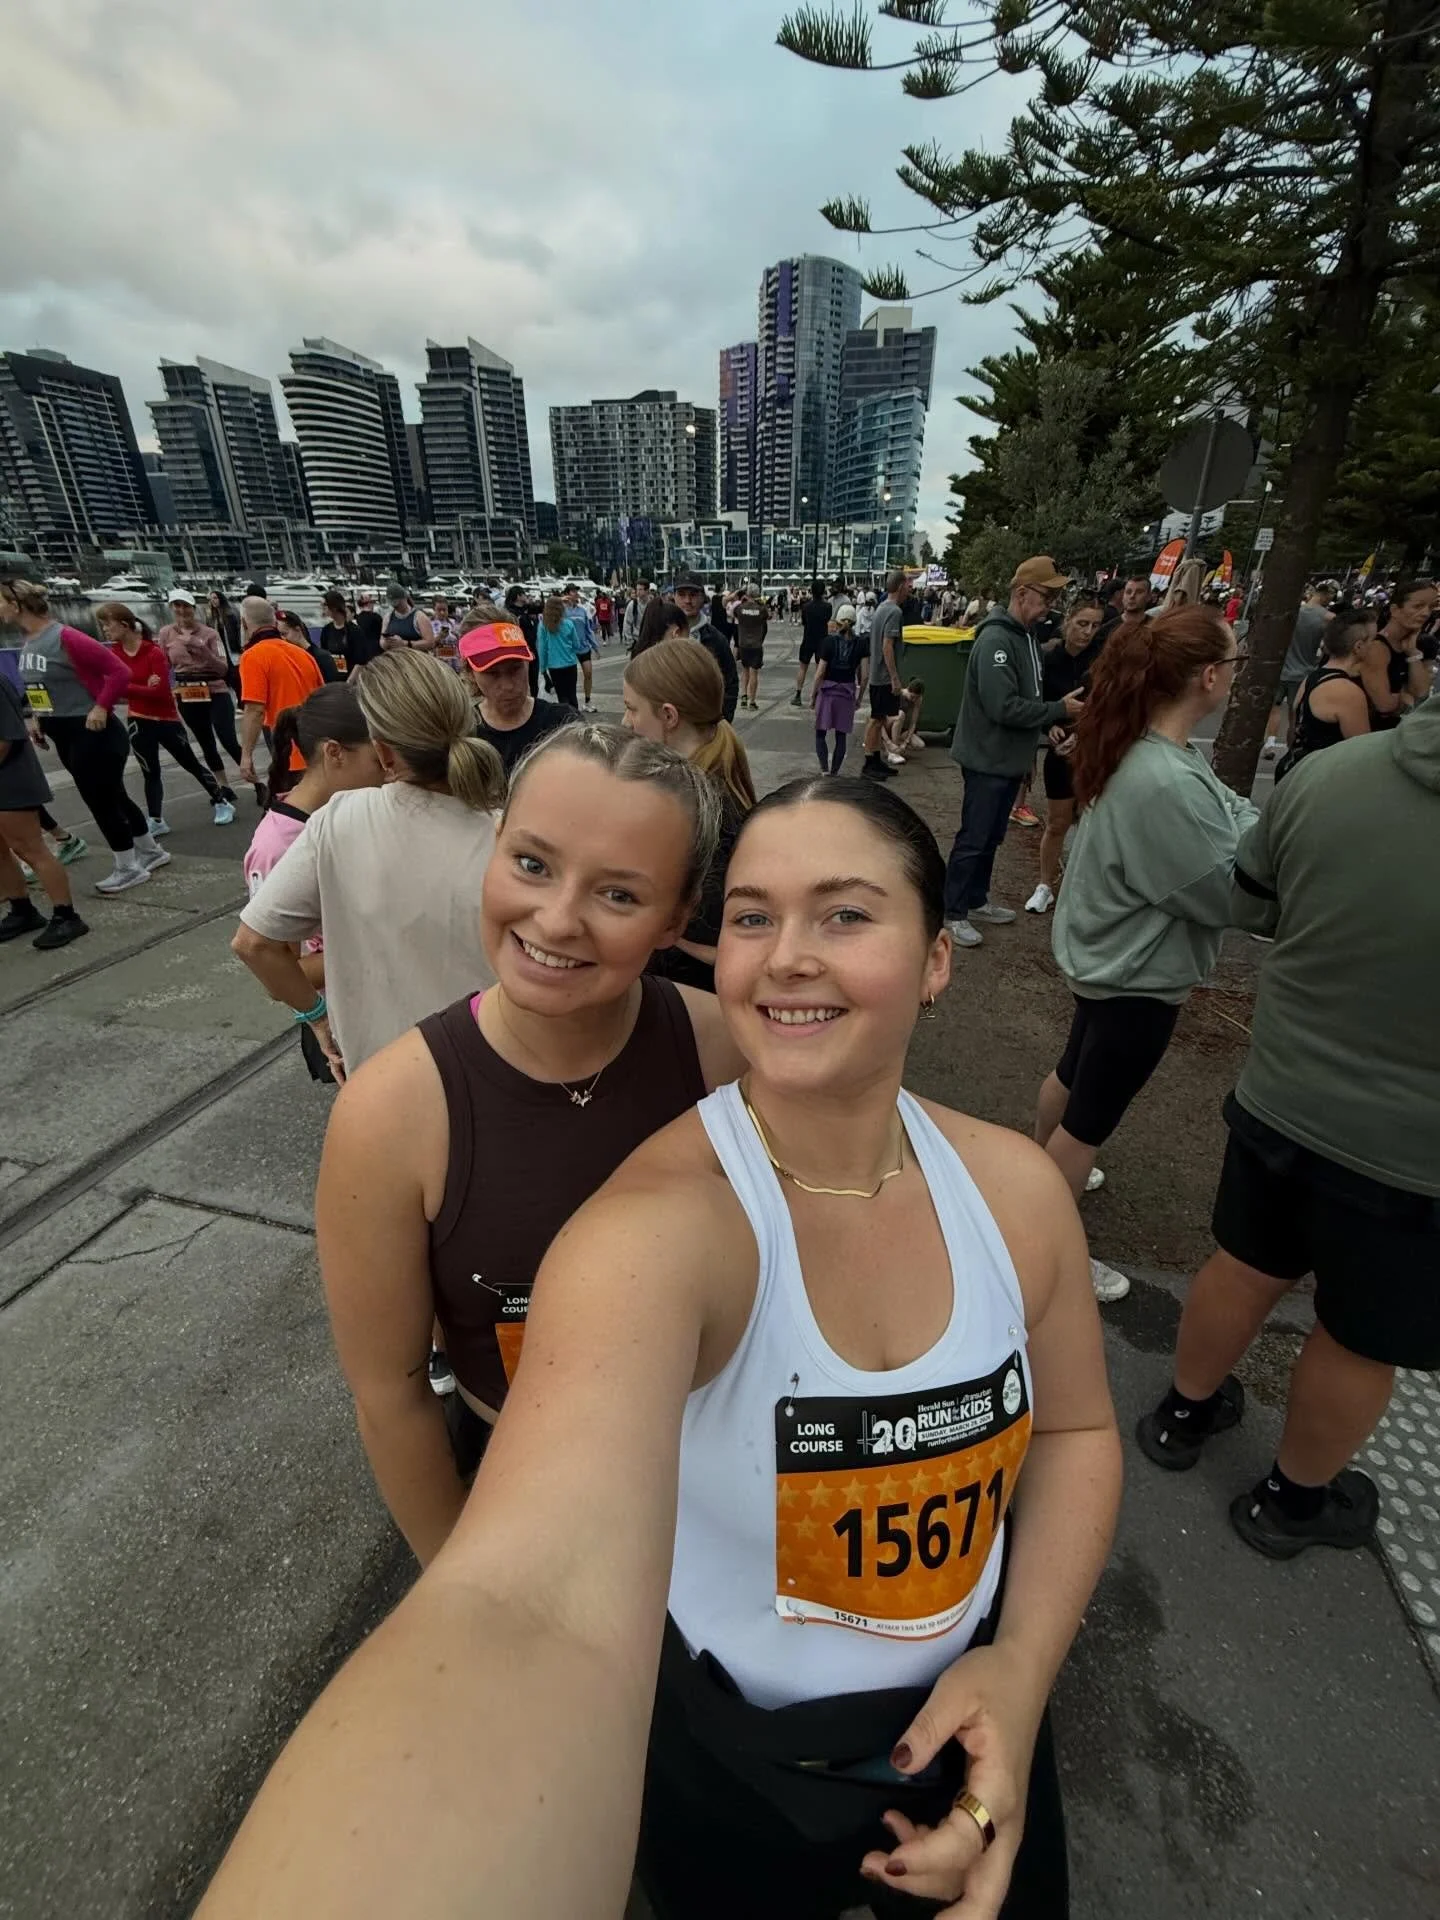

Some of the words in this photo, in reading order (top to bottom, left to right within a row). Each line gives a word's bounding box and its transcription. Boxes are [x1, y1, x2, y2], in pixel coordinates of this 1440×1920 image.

[507, 1296, 531, 1305] LON
[918, 1402, 940, 1412] Herald
[942, 1400, 955, 1408] Sun
[918, 1408, 952, 1429] RUN
[797, 1423, 835, 1436] LONG
[872, 1417, 917, 1455] 20
[790, 1440, 843, 1453] COURSE
[832, 1467, 1003, 1578] 15671
[834, 1611, 868, 1628] 15671
